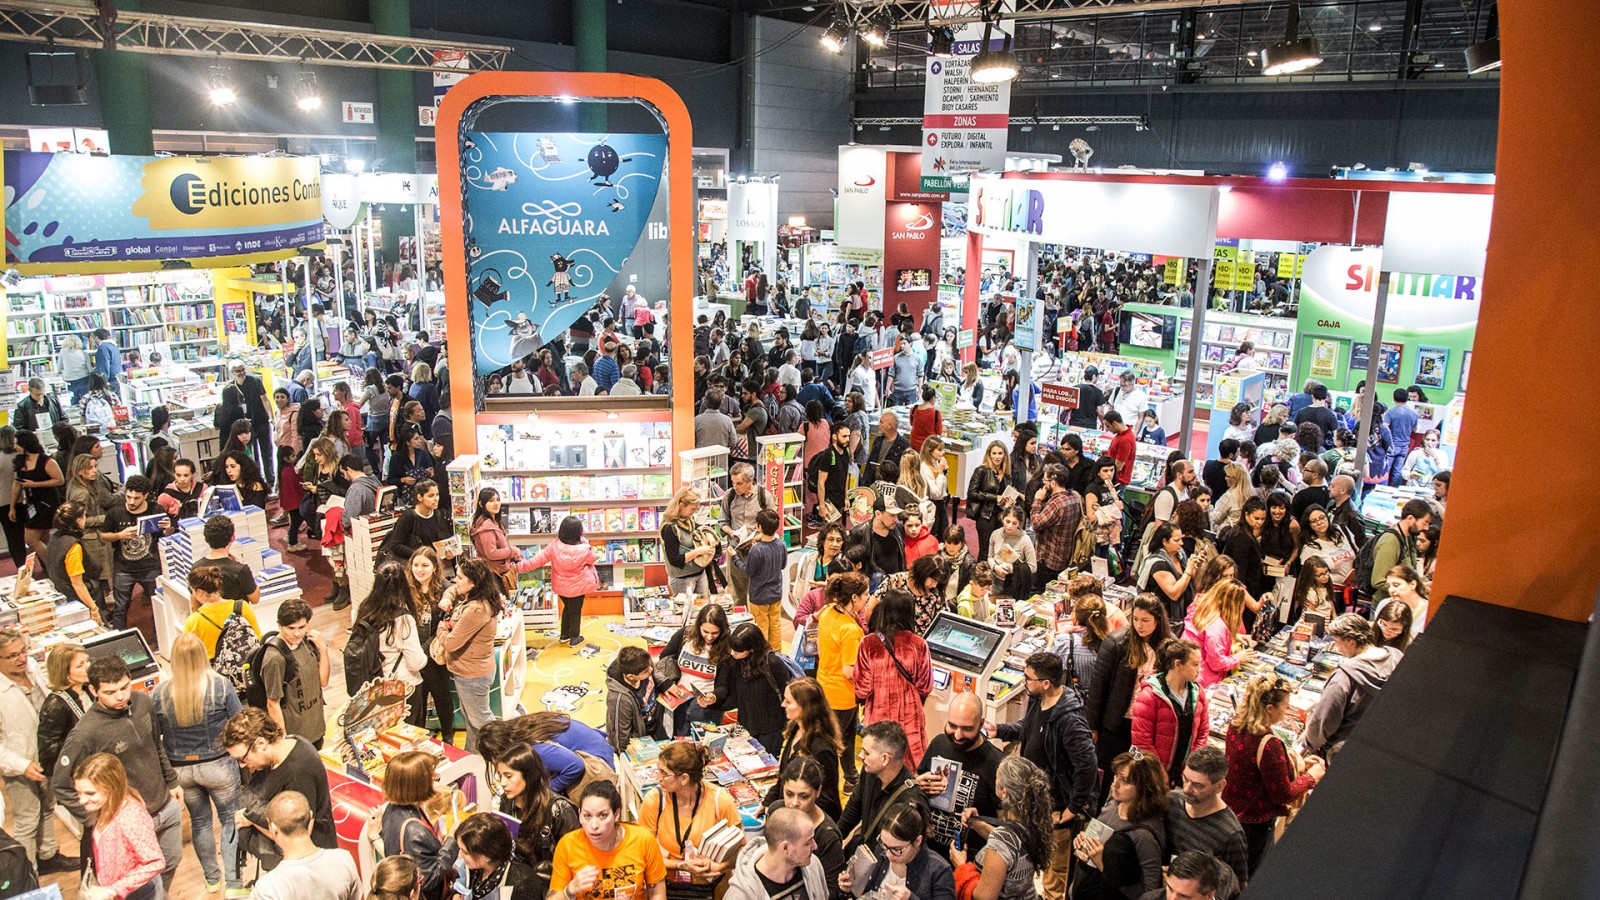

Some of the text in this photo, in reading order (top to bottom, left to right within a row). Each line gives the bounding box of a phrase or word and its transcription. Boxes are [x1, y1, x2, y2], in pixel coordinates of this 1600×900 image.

[958, 43, 980, 53] SALAS
[945, 69, 962, 77] WALSH
[943, 86, 962, 94] STORNI
[967, 84, 999, 93] HERNÁNDEZ
[942, 94, 963, 103] OCAMPO
[969, 93, 999, 102] SARMIENTO
[942, 103, 978, 111] BIOY CASARES
[953, 116, 977, 127] ZONAS
[941, 132, 961, 141] FUTURO
[967, 132, 986, 140] DIGITAL
[941, 141, 964, 149] EXPLORA
[970, 141, 993, 149] INFANTIL
[924, 178, 952, 188] PABELLÓN
[498, 218, 610, 236] ALFAGUARA
[892, 231, 926, 240] SAN PABLO
[244, 240, 261, 248] INDE
[125, 246, 151, 256] global
[1317, 319, 1341, 329] CAJA
[1055, 395, 1077, 404] CHICOS
